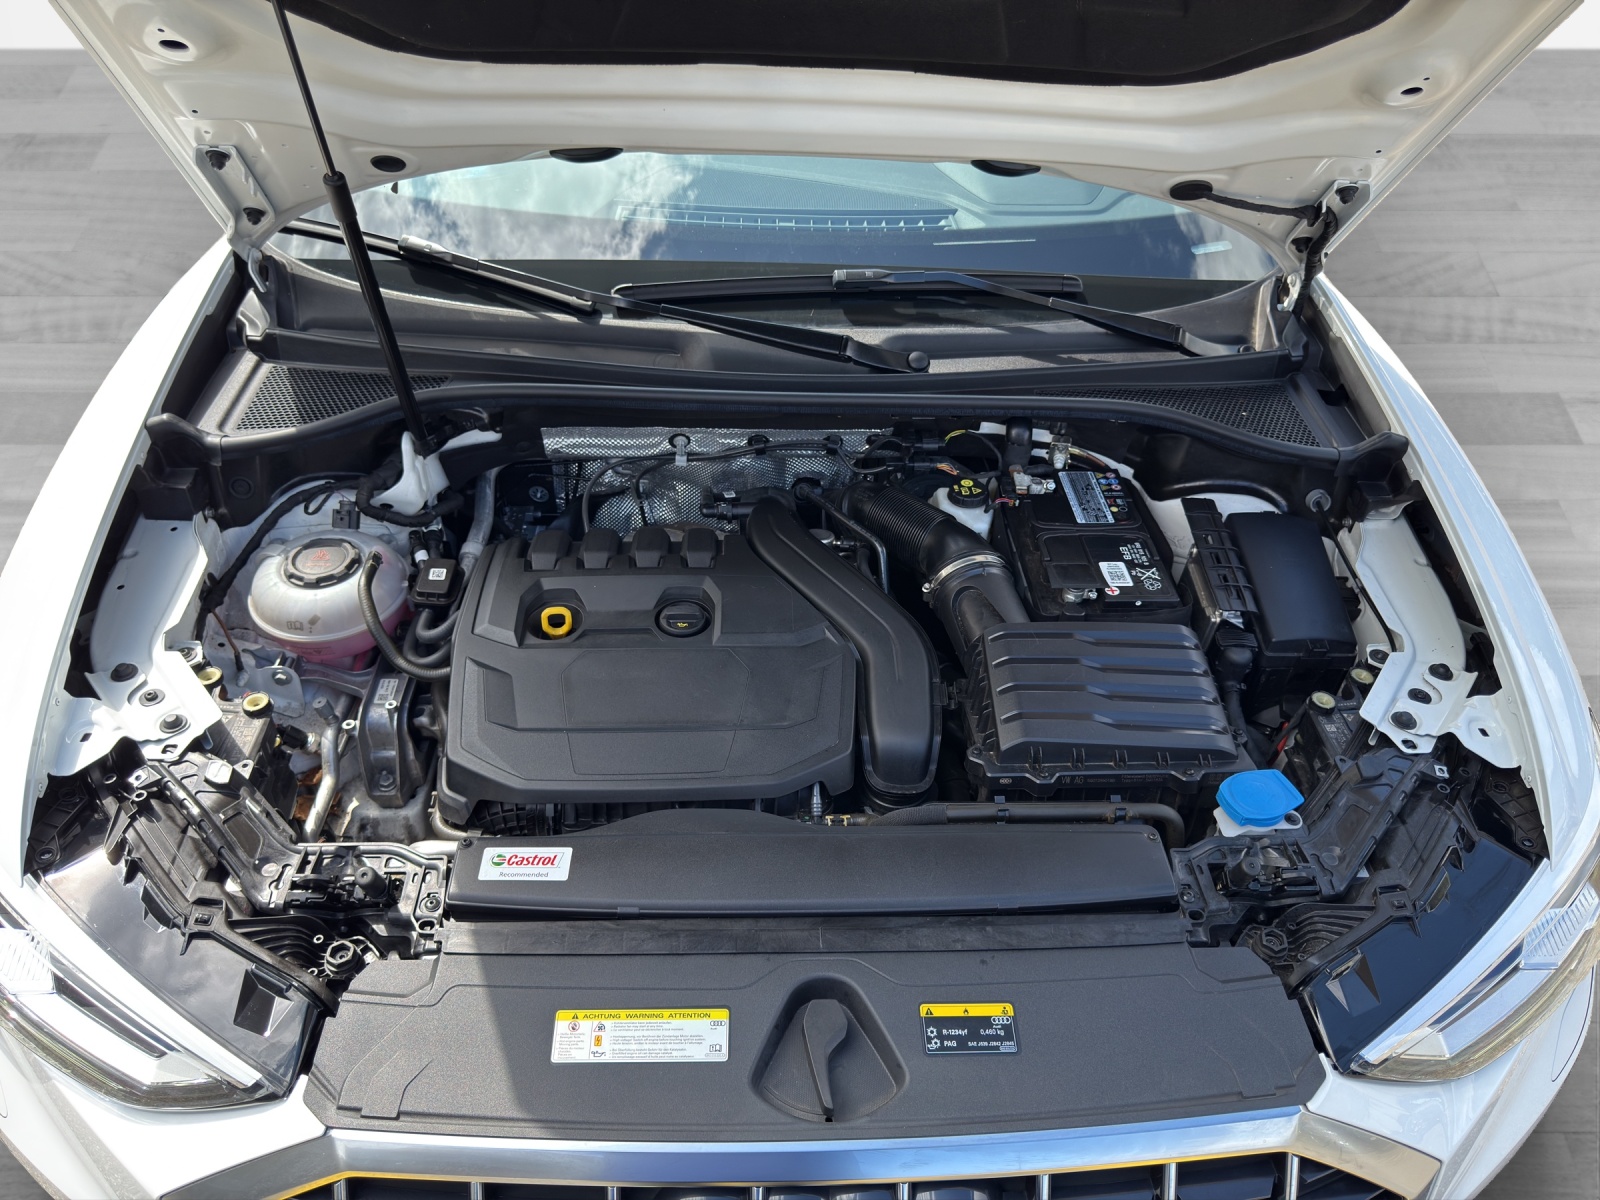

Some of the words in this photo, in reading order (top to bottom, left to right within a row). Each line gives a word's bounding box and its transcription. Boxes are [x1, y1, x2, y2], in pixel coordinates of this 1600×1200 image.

[1119, 546, 1132, 560] EFB
[507, 854, 558, 866] Castrol
[942, 1028, 968, 1036] R-1234yf
[997, 1028, 1004, 1036] kg
